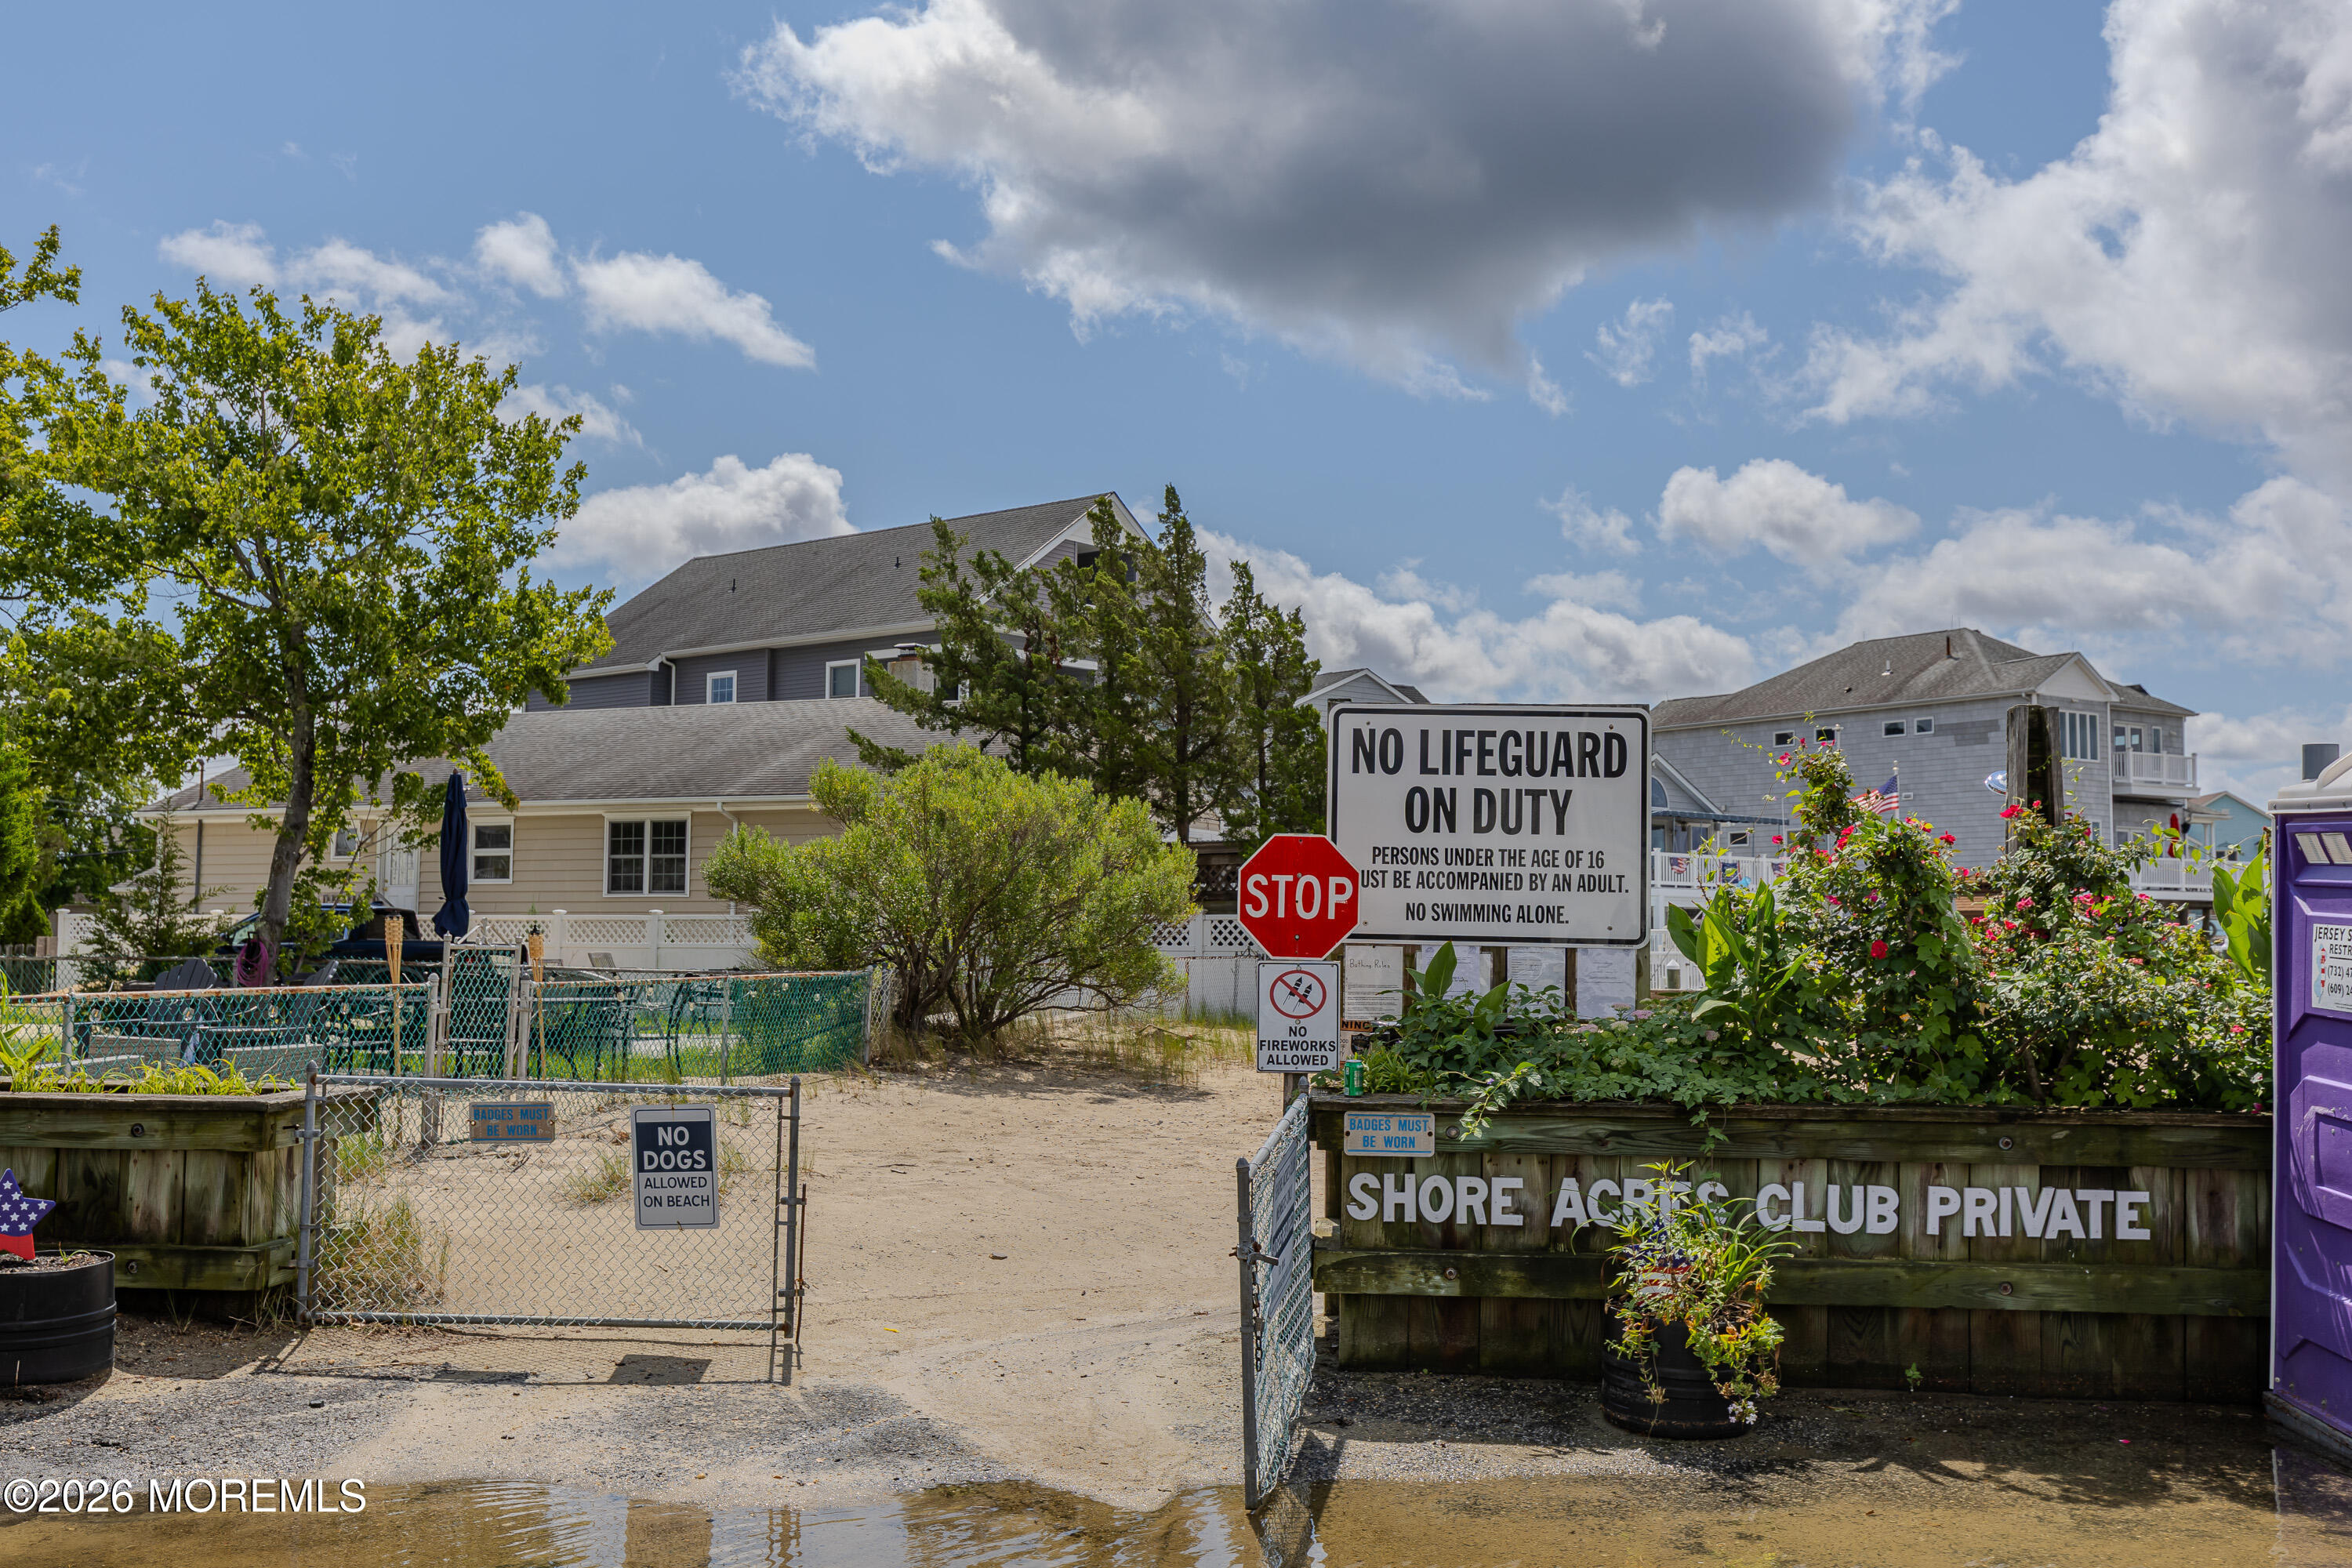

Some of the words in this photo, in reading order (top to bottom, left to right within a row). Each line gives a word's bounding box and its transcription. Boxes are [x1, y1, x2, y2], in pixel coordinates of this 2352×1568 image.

[1352, 727, 1404, 775] NO
[1419, 728, 1628, 779] LIFEGUARD
[1404, 786, 1457, 833] ON
[1473, 787, 1573, 835] DUTY
[1372, 846, 1439, 866] PERSONS
[1444, 848, 1494, 866] UNDER
[1498, 848, 1526, 867] THE
[1530, 849, 1560, 869] AGE
[1565, 851, 1583, 869] OF
[1588, 851, 1605, 869] 16
[1361, 869, 1388, 889] UST
[1392, 870, 1411, 889] BE
[1416, 871, 1523, 891] ACCOMPANIED
[1529, 873, 1548, 891] BY
[1552, 873, 1572, 892] AN
[1577, 874, 1629, 894] ADULT.
[1245, 873, 1353, 920] STOP
[1406, 902, 1426, 921] NO
[1431, 903, 1512, 923] SWIMMING
[1516, 905, 1569, 924] ALONE.
[2314, 927, 2346, 942] JERSEY
[2329, 943, 2352, 956] RESTR
[2328, 965, 2344, 980] (732)
[2327, 982, 2344, 997] (609)
[1289, 1026, 1307, 1037] NO
[1260, 1040, 1336, 1051] FIREWORKS
[1266, 1054, 1329, 1065] ALLOWED
[474, 1108, 514, 1120] BADGES
[520, 1108, 549, 1120] MUST
[487, 1124, 499, 1136] BE
[506, 1124, 537, 1136] WORN
[1348, 1118, 1391, 1131] BADGES
[1398, 1119, 1429, 1132] MUST
[658, 1126, 689, 1146] NO
[1363, 1135, 1376, 1148] BE
[1383, 1136, 1416, 1149] WORN
[643, 1149, 706, 1170] DOGS
[644, 1177, 707, 1189] ALLOWED
[643, 1196, 662, 1207] ON
[667, 1195, 710, 1207] BEACH
[1346, 1172, 1524, 1226] SHORE
[1756, 1181, 1899, 1236] CLUB
[1926, 1185, 2151, 1240] PRIVATE
